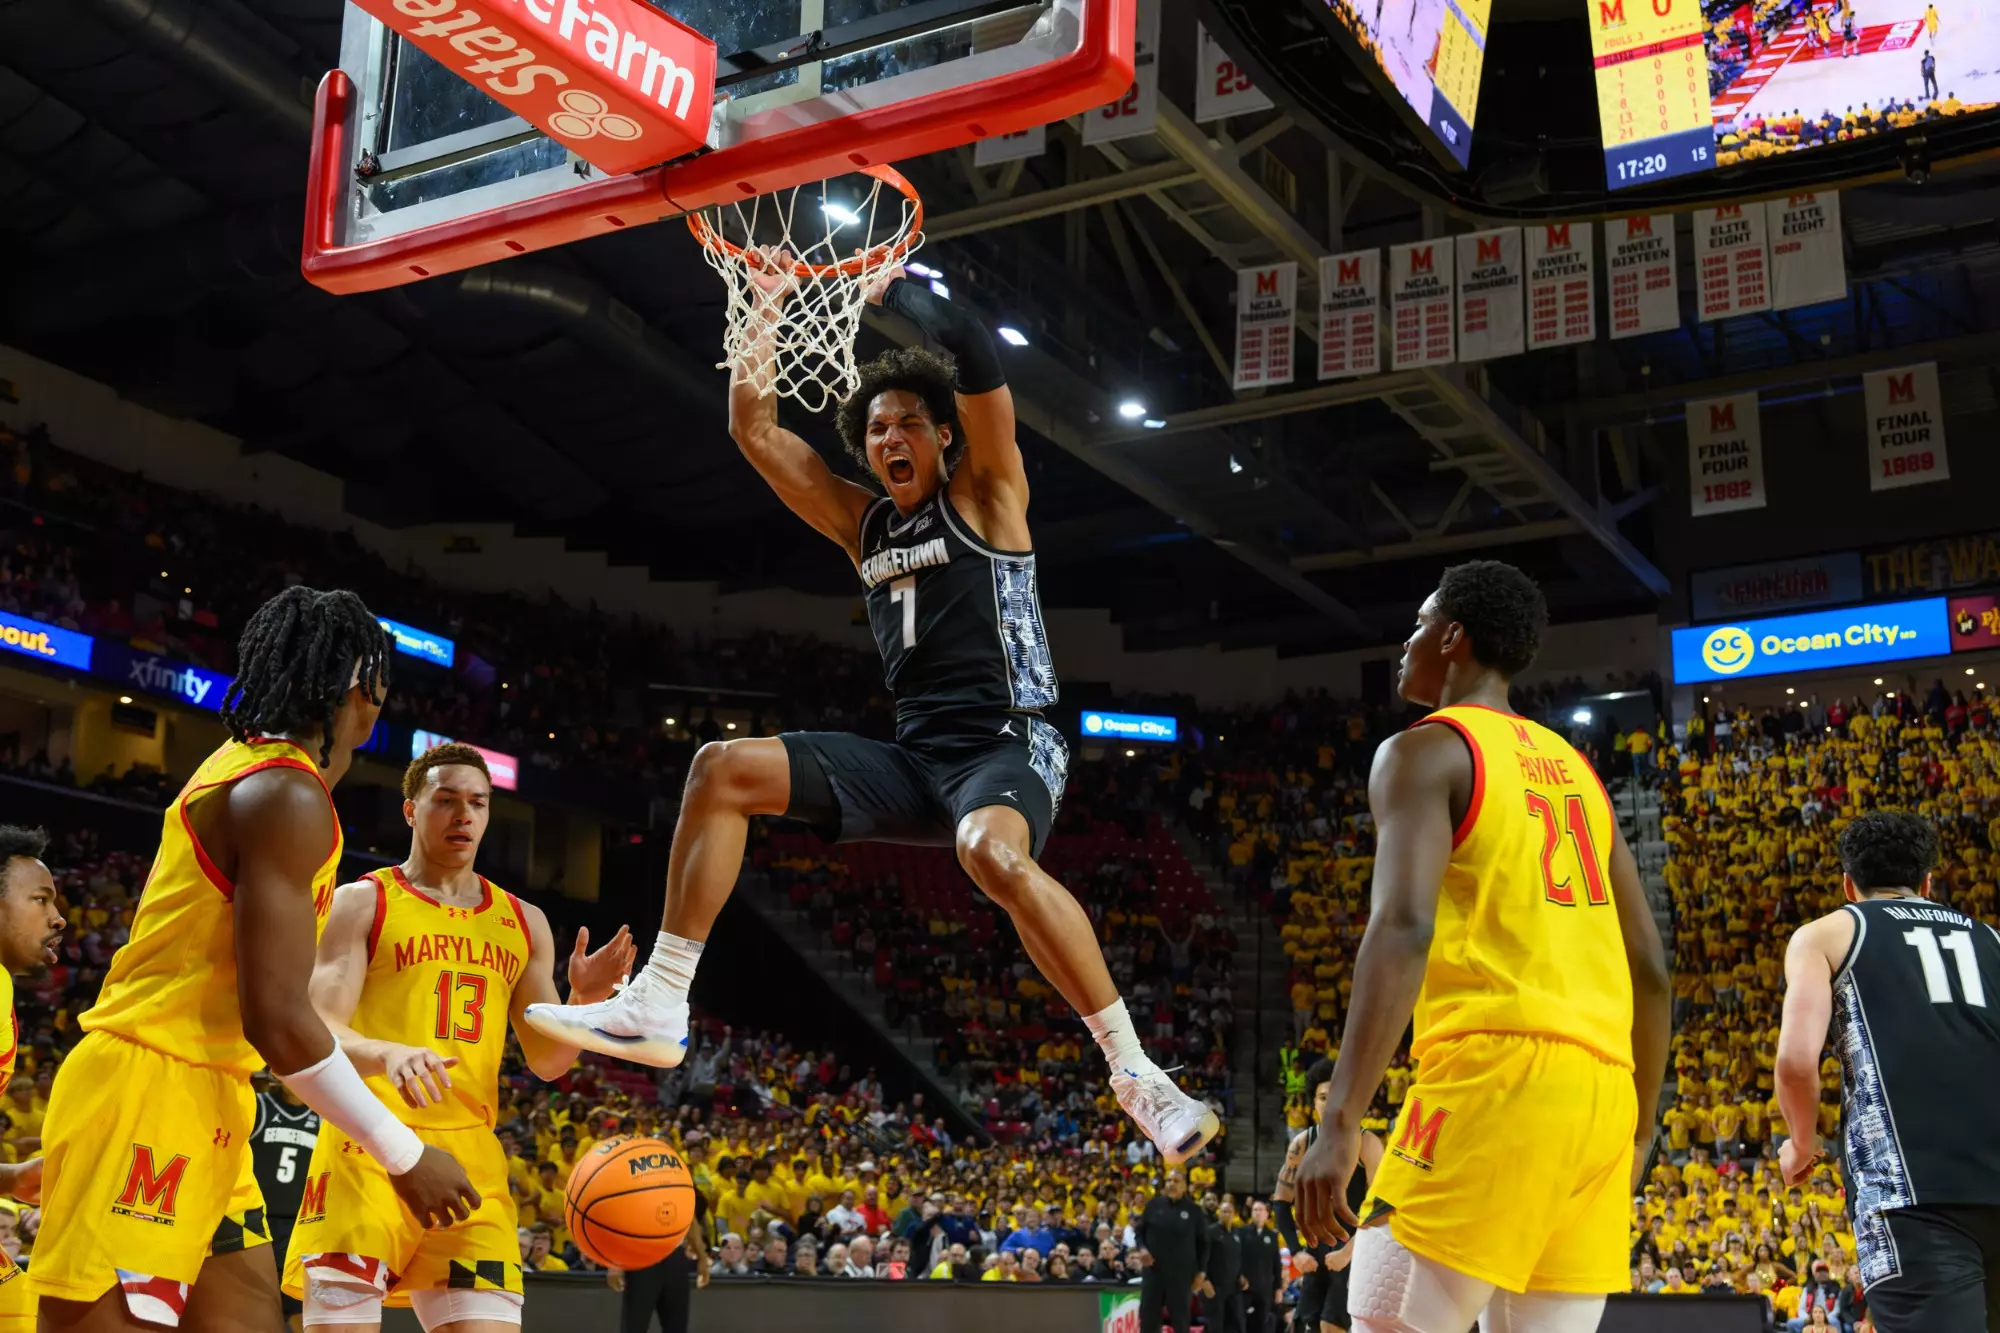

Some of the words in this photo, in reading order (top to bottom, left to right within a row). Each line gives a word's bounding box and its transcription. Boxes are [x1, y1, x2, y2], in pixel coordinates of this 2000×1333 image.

[1618, 154, 1667, 180] 17:20
[1691, 147, 1708, 162] 15
[1711, 221, 1749, 236] ELITE
[1783, 207, 1822, 224] ELITE
[1783, 218, 1825, 236] EIGHT
[1478, 235, 1501, 266] M
[1547, 223, 1571, 252] M
[1618, 237, 1663, 255] SWEET
[1709, 232, 1752, 249] EIGHT
[1338, 257, 1361, 287] M
[1410, 246, 1433, 276] M
[1532, 262, 1588, 280] SIXTEEN
[1537, 252, 1581, 267] SWEET
[1612, 248, 1670, 268] SIXTEEN
[1256, 270, 1277, 297] M
[1405, 277, 1439, 290] NCAA
[1471, 266, 1507, 280] NCAA
[1250, 300, 1282, 311] NCAA
[1332, 287, 1365, 300] NCAA
[1887, 373, 1915, 405] M
[1709, 403, 1736, 434] M
[1877, 410, 1932, 433] FINAL
[1698, 440, 1750, 459] FINAL
[1881, 428, 1930, 449] FOUR
[1702, 456, 1748, 475] FOUR
[861, 537, 950, 589] GEORGETOWN
[1866, 546, 1931, 594] THE
[890, 574, 917, 650] 7
[0, 624, 56, 656] out.
[1761, 631, 1841, 656] Ocean
[1844, 623, 1900, 646] City
[129, 657, 212, 704] xfinity
[1515, 751, 1575, 785] PAYNE
[1525, 789, 1609, 906] 21
[1882, 906, 1972, 929] HALAIFONUA
[394, 934, 520, 986] MARYLAND
[1902, 926, 1987, 1008] 11
[434, 970, 488, 1044] 13
[263, 1127, 318, 1149] GEORGETOW
[1396, 1096, 1452, 1164] M
[276, 1147, 298, 1184] 5
[629, 1153, 683, 1175] NCAA
[115, 1143, 191, 1217] M
[300, 1172, 331, 1219] M
